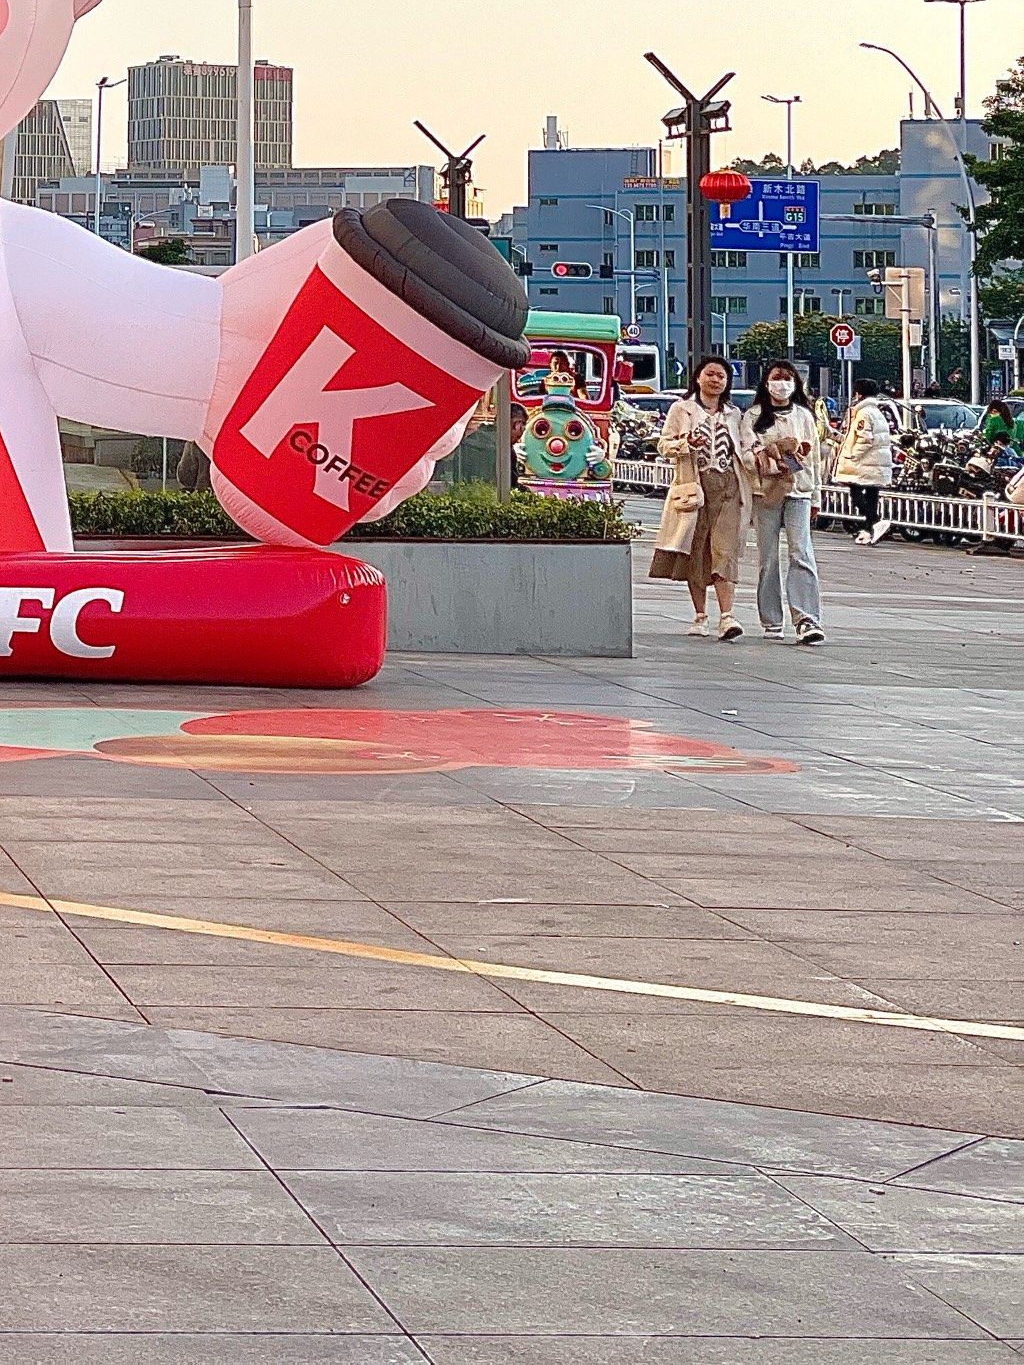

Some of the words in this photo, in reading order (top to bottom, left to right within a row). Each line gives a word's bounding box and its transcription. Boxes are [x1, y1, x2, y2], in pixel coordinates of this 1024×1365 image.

[762, 184, 806, 195] 新木北路
[785, 212, 804, 223] G15
[628, 326, 638, 335] 40
[238, 324, 437, 513] K
[288, 431, 391, 500] COFFEE
